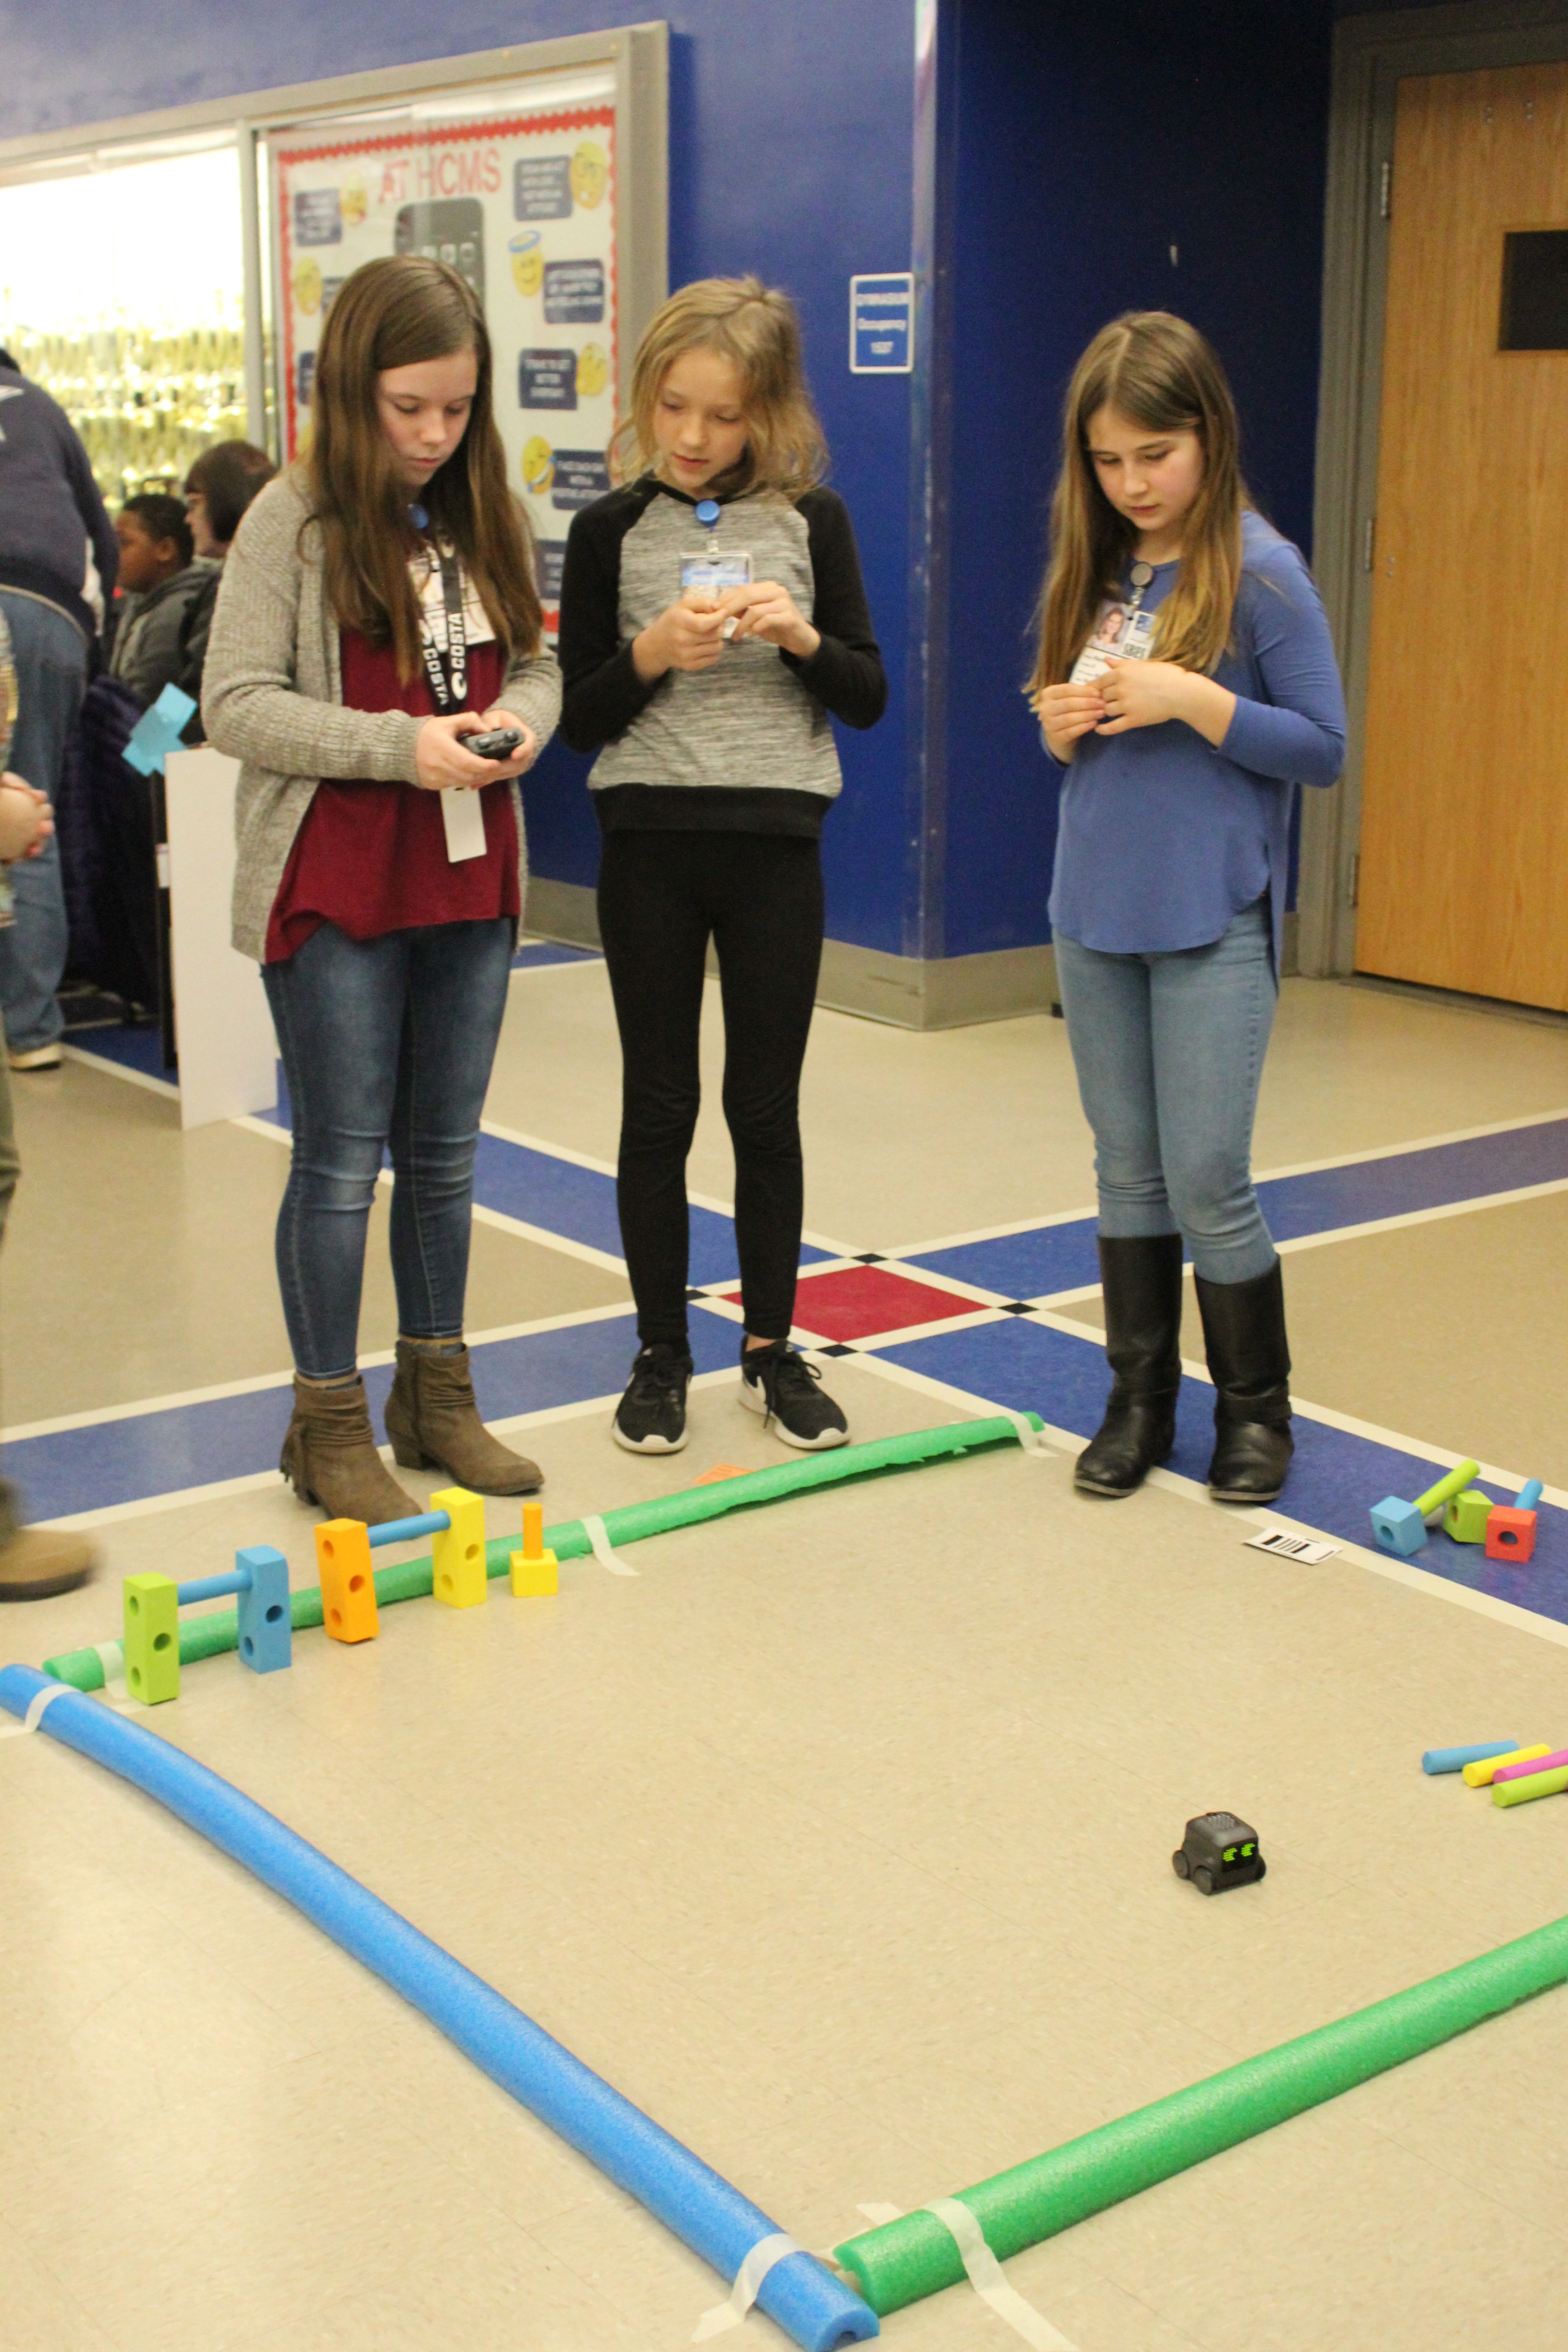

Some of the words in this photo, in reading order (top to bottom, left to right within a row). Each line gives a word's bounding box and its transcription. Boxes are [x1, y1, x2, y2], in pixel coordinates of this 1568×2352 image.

[378, 159, 410, 205] AT
[416, 147, 501, 199] HCMS
[447, 612, 466, 669] COSTA
[422, 647, 449, 706] COSTA
